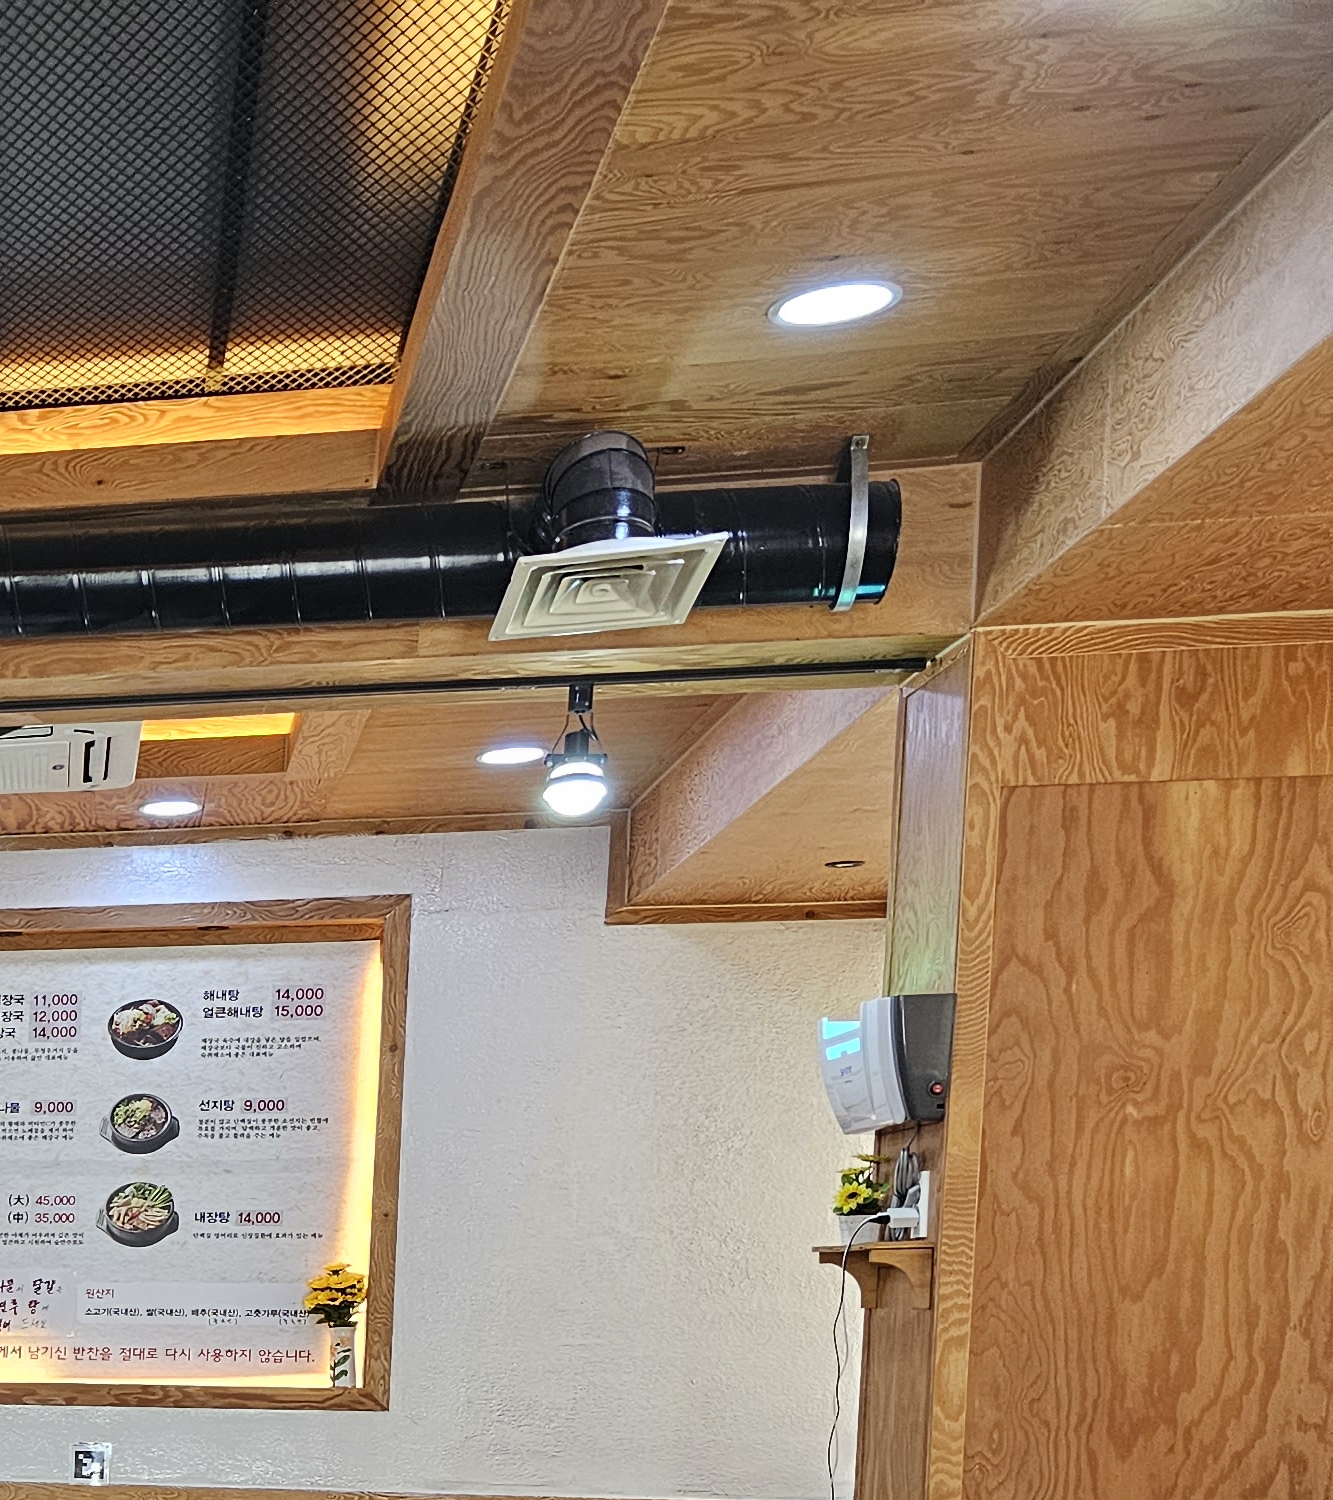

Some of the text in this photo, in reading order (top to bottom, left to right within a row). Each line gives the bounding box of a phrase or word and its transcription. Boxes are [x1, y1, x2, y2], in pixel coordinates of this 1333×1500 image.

[33, 994, 78, 1007] 11,000
[203, 988, 324, 1001] 해내탕 14,000
[33, 1010, 78, 1023] 12,000
[202, 1005, 324, 1018] 얼큰해내탕 15,000
[33, 1026, 77, 1040] 14,000
[34, 1101, 74, 1114] 9,000
[198, 1099, 285, 1113] 선지탕 9,000
[8, 1194, 30, 1207] (大)
[7, 1211, 29, 1224] (中)
[194, 1211, 281, 1225] 내장탕 14,000
[85, 1288, 115, 1299] 원산지
[28, 1346, 67, 1361] 남기신
[72, 1346, 112, 1361] 반찬을
[119, 1347, 159, 1362] 절대로
[165, 1347, 191, 1362] 다시
[197, 1347, 253, 1363] 사용하지
[258, 1348, 315, 1364] 않습니다.
